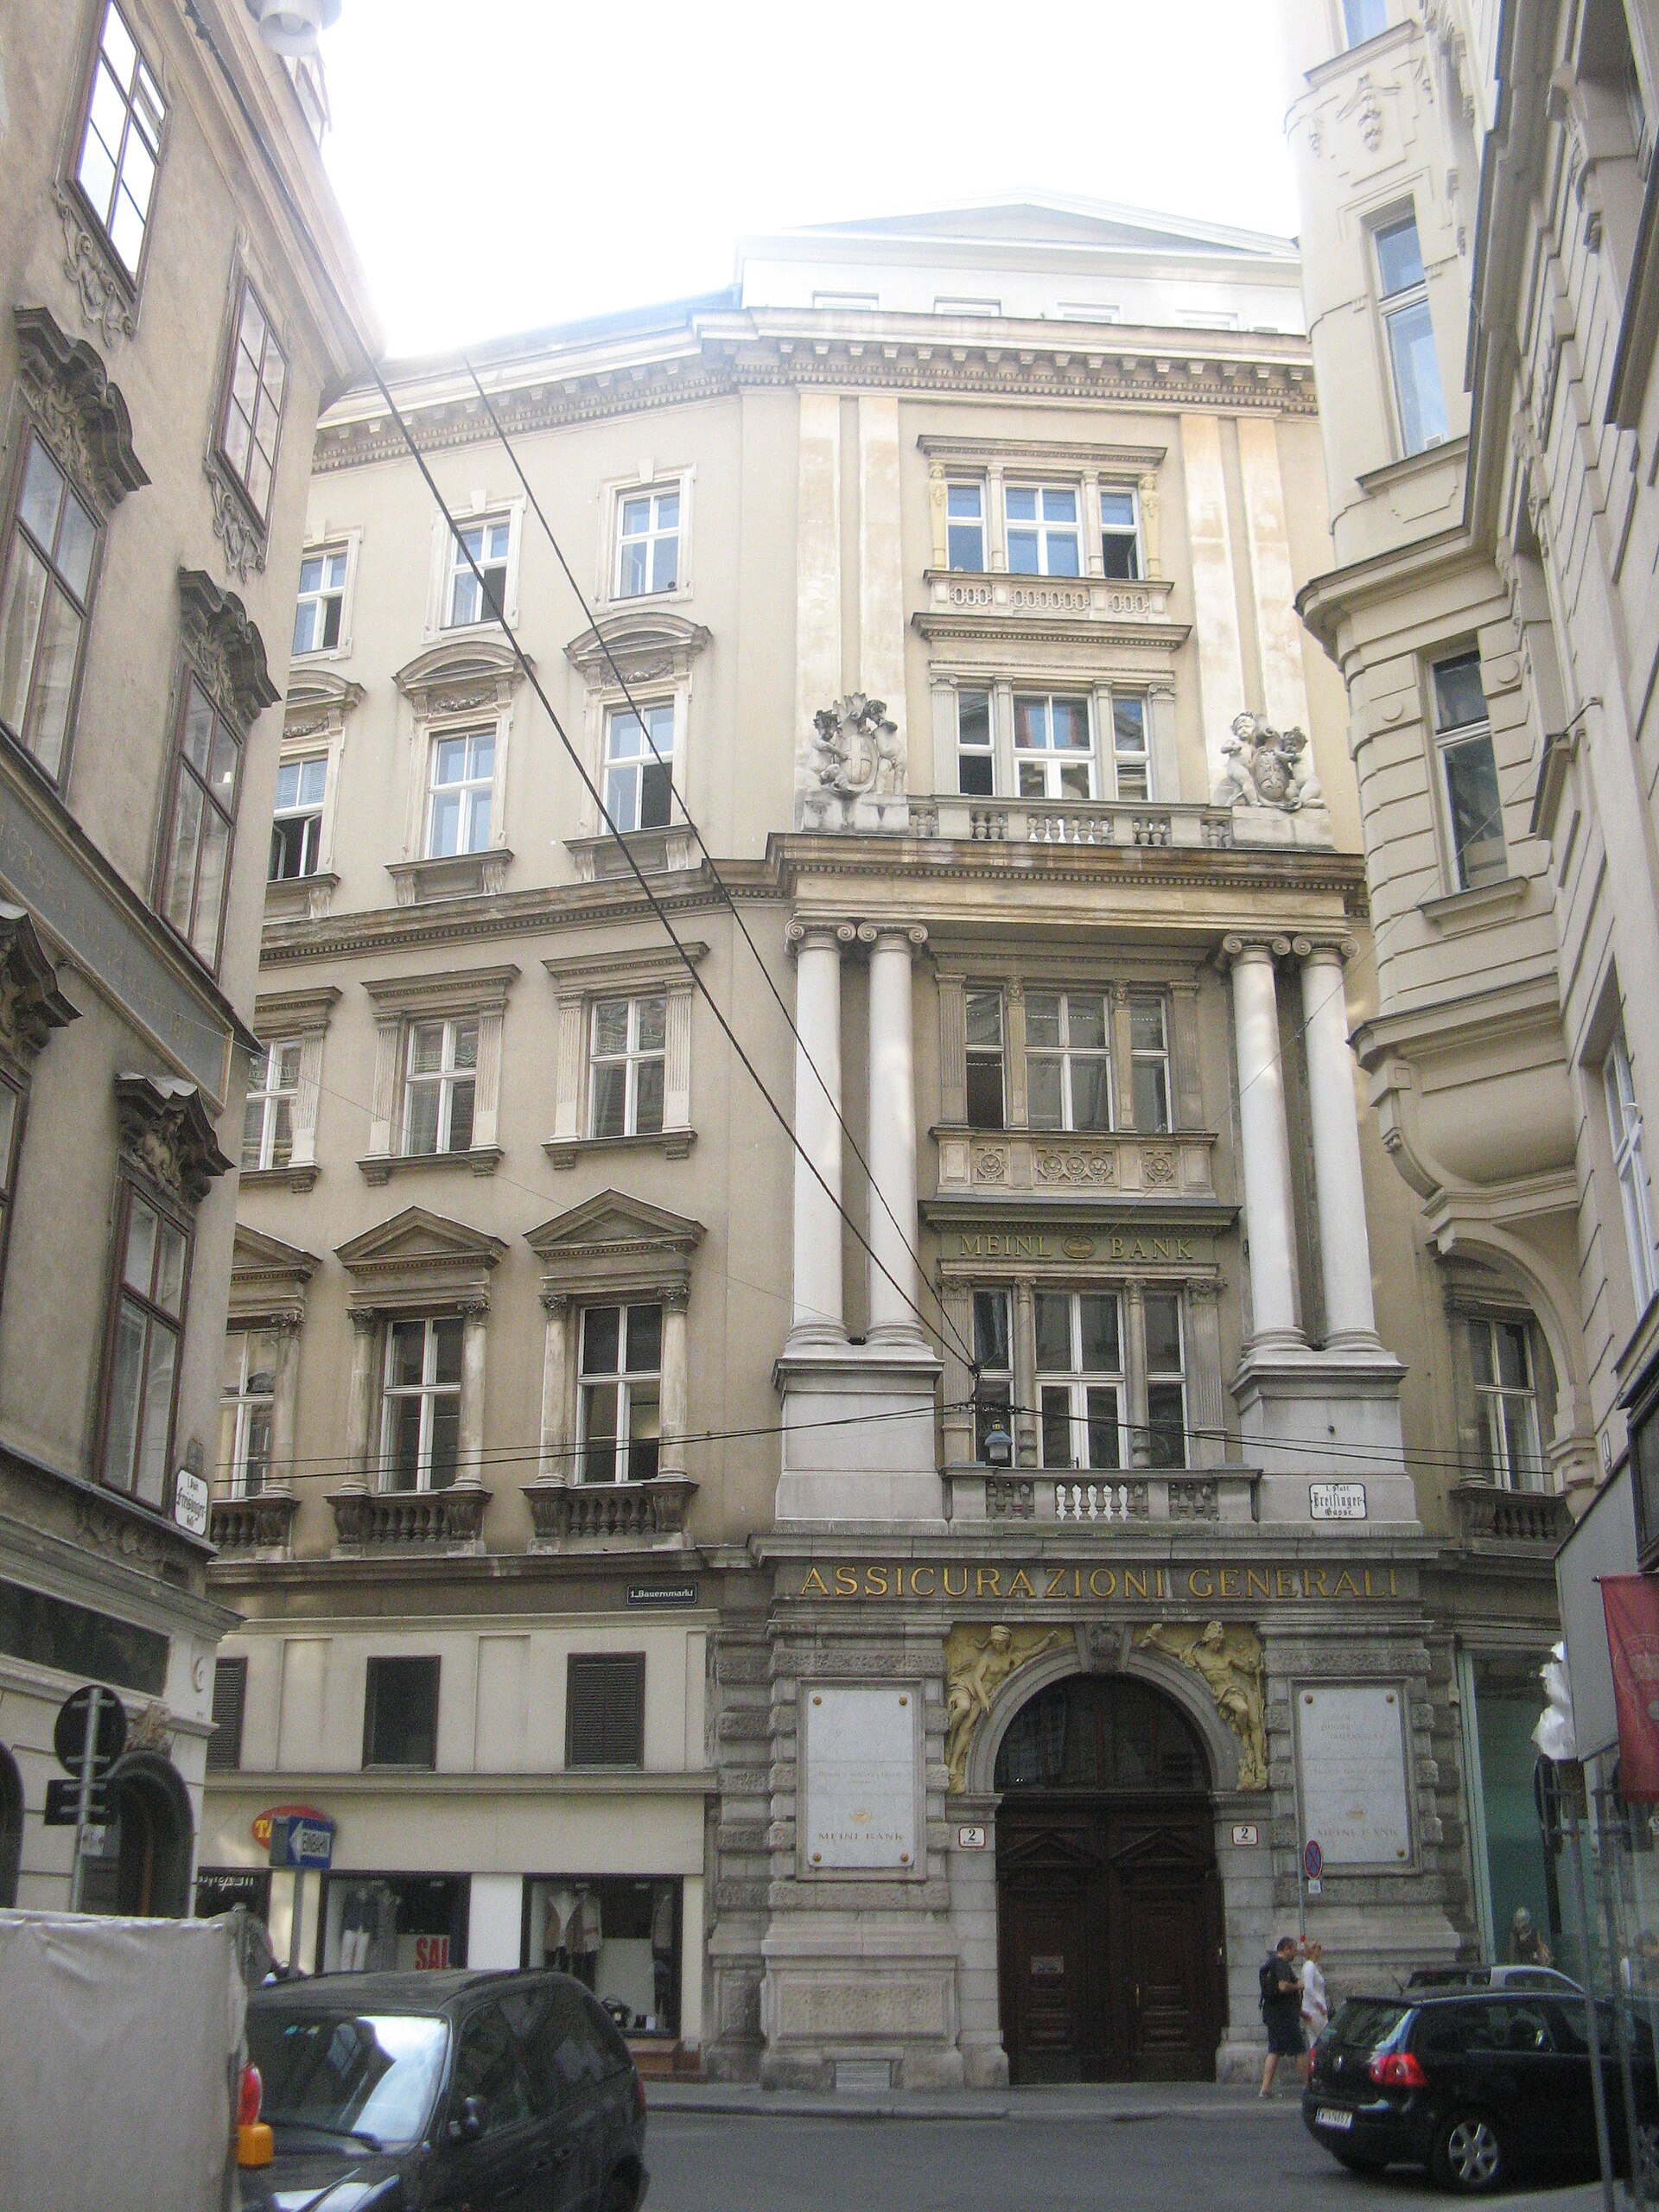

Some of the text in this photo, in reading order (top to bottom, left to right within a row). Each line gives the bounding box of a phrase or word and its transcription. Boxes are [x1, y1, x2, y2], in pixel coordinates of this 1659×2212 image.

[959, 1235, 1193, 1259] MEINL BANK
[799, 1567, 1397, 1598] ASSICURAZIONI GENERALI
[968, 1828, 976, 1840] 2
[1241, 1827, 1249, 1840] 2
